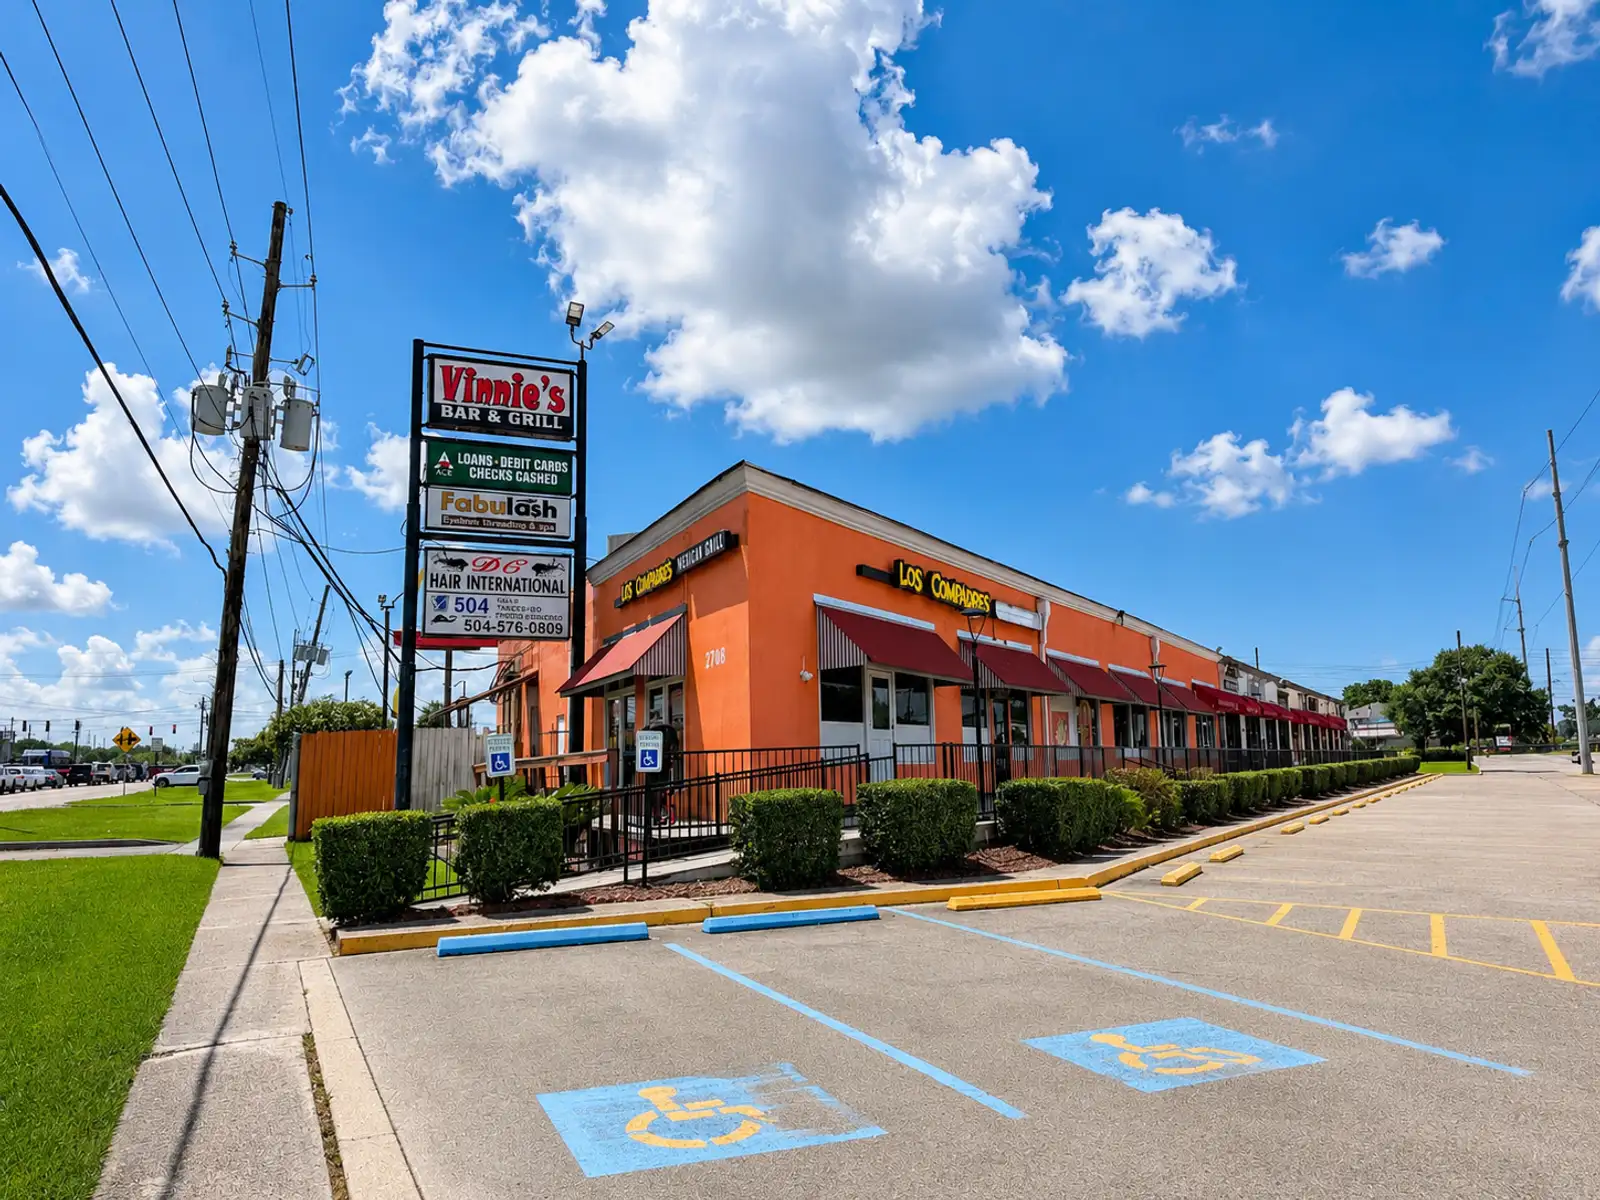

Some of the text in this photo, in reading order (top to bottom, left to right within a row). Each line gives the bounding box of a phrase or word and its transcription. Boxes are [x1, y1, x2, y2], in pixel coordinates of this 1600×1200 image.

[440, 365, 566, 413] Vinnie's
[441, 404, 563, 430] BAR & GRILL
[435, 469, 453, 477] ACE
[469, 466, 558, 485] CHECKS CASHED
[500, 456, 530, 470] DEBIT
[533, 459, 569, 473] CARDS
[440, 491, 557, 519] Fabulash
[430, 572, 566, 594] HAIR INTERNATIONAL
[899, 561, 991, 613] LOS COMPADRES
[454, 596, 489, 614] 504
[464, 619, 564, 634] 504-576-0809
[704, 647, 727, 669] 2708
